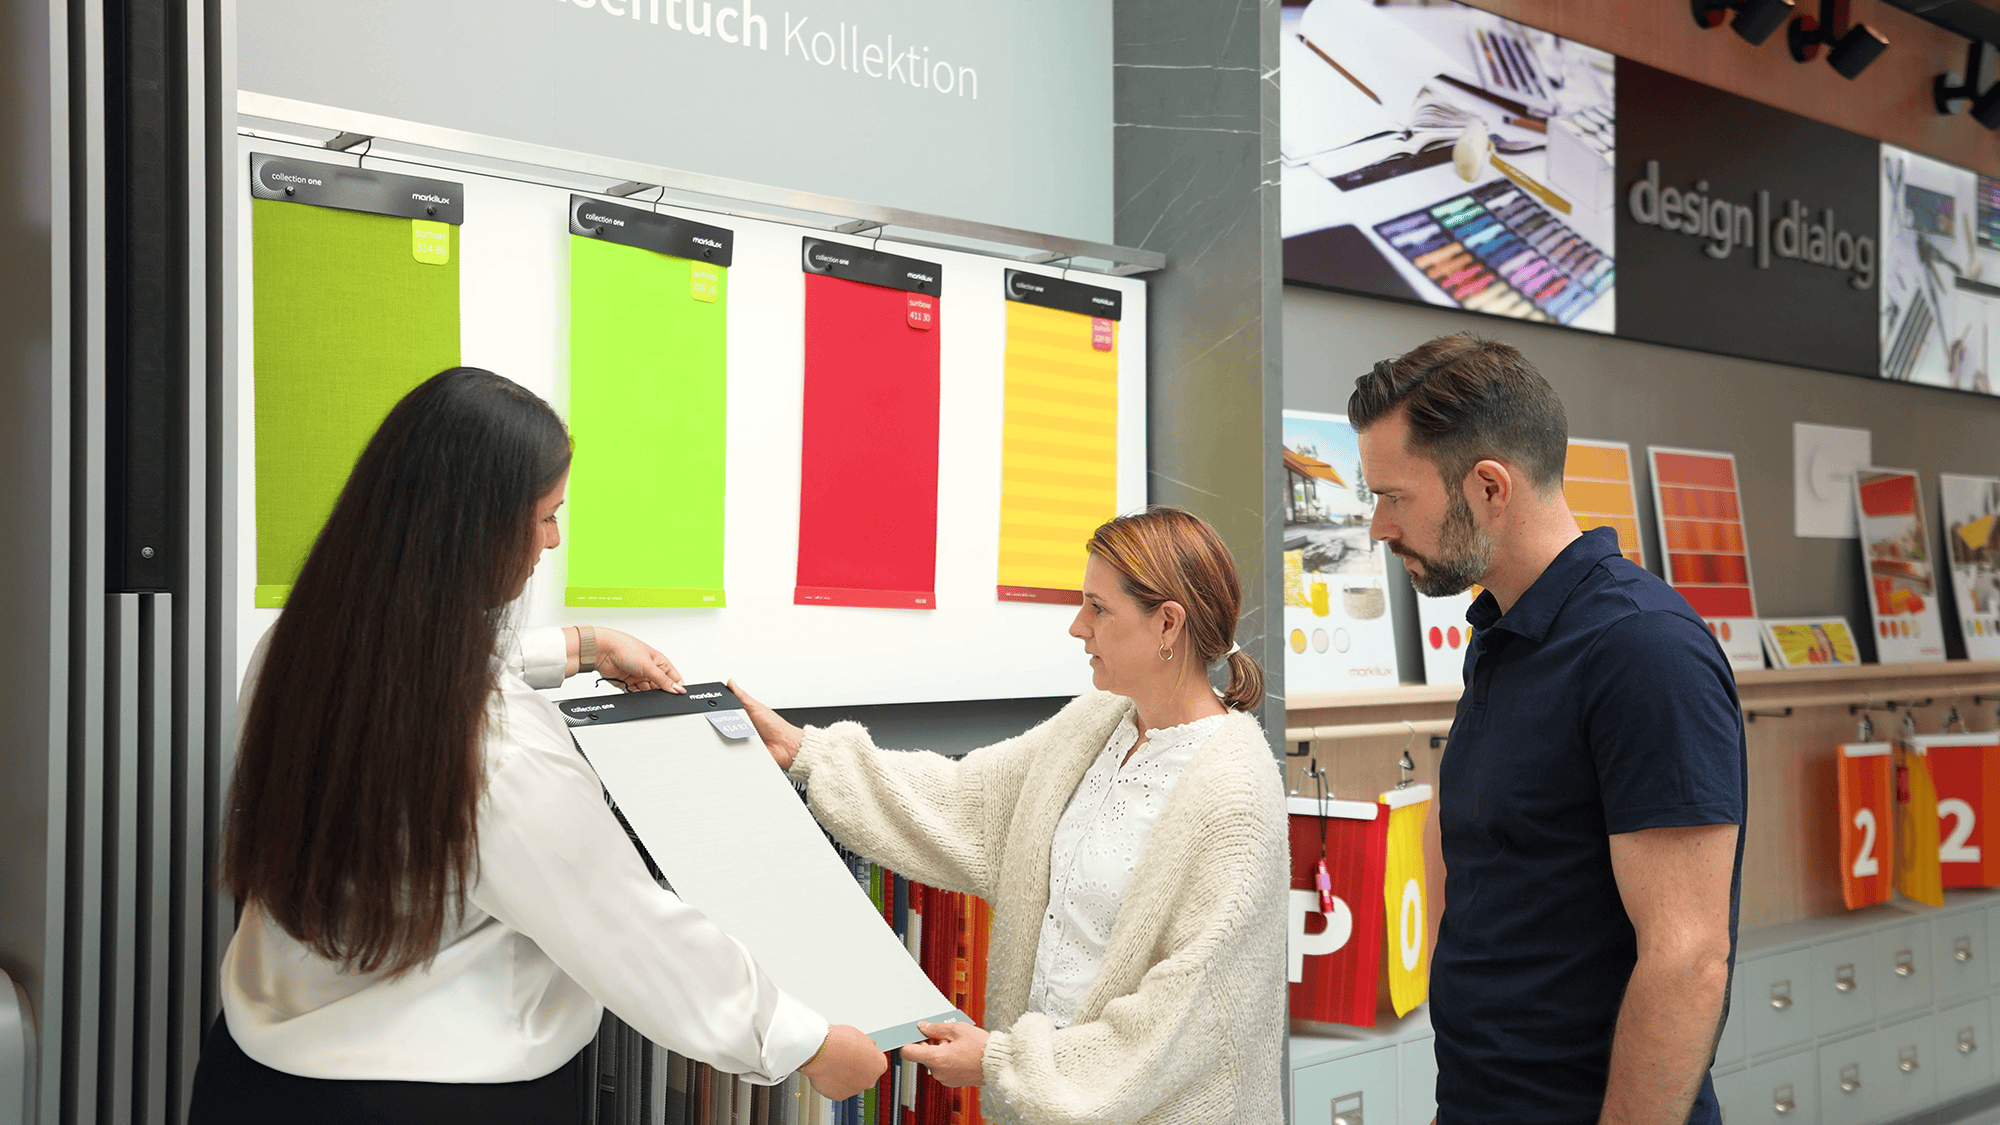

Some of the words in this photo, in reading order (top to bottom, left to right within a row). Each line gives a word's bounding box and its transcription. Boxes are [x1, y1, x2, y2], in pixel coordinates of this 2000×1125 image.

[784, 11, 979, 100] Kollektion
[271, 172, 307, 184] collection
[307, 178, 323, 187] one
[411, 193, 450, 205] markilux
[585, 213, 613, 226] collection
[613, 219, 625, 228] one
[839, 258, 850, 266] one
[1852, 808, 1879, 878] 2
[1937, 798, 1982, 863] 2
